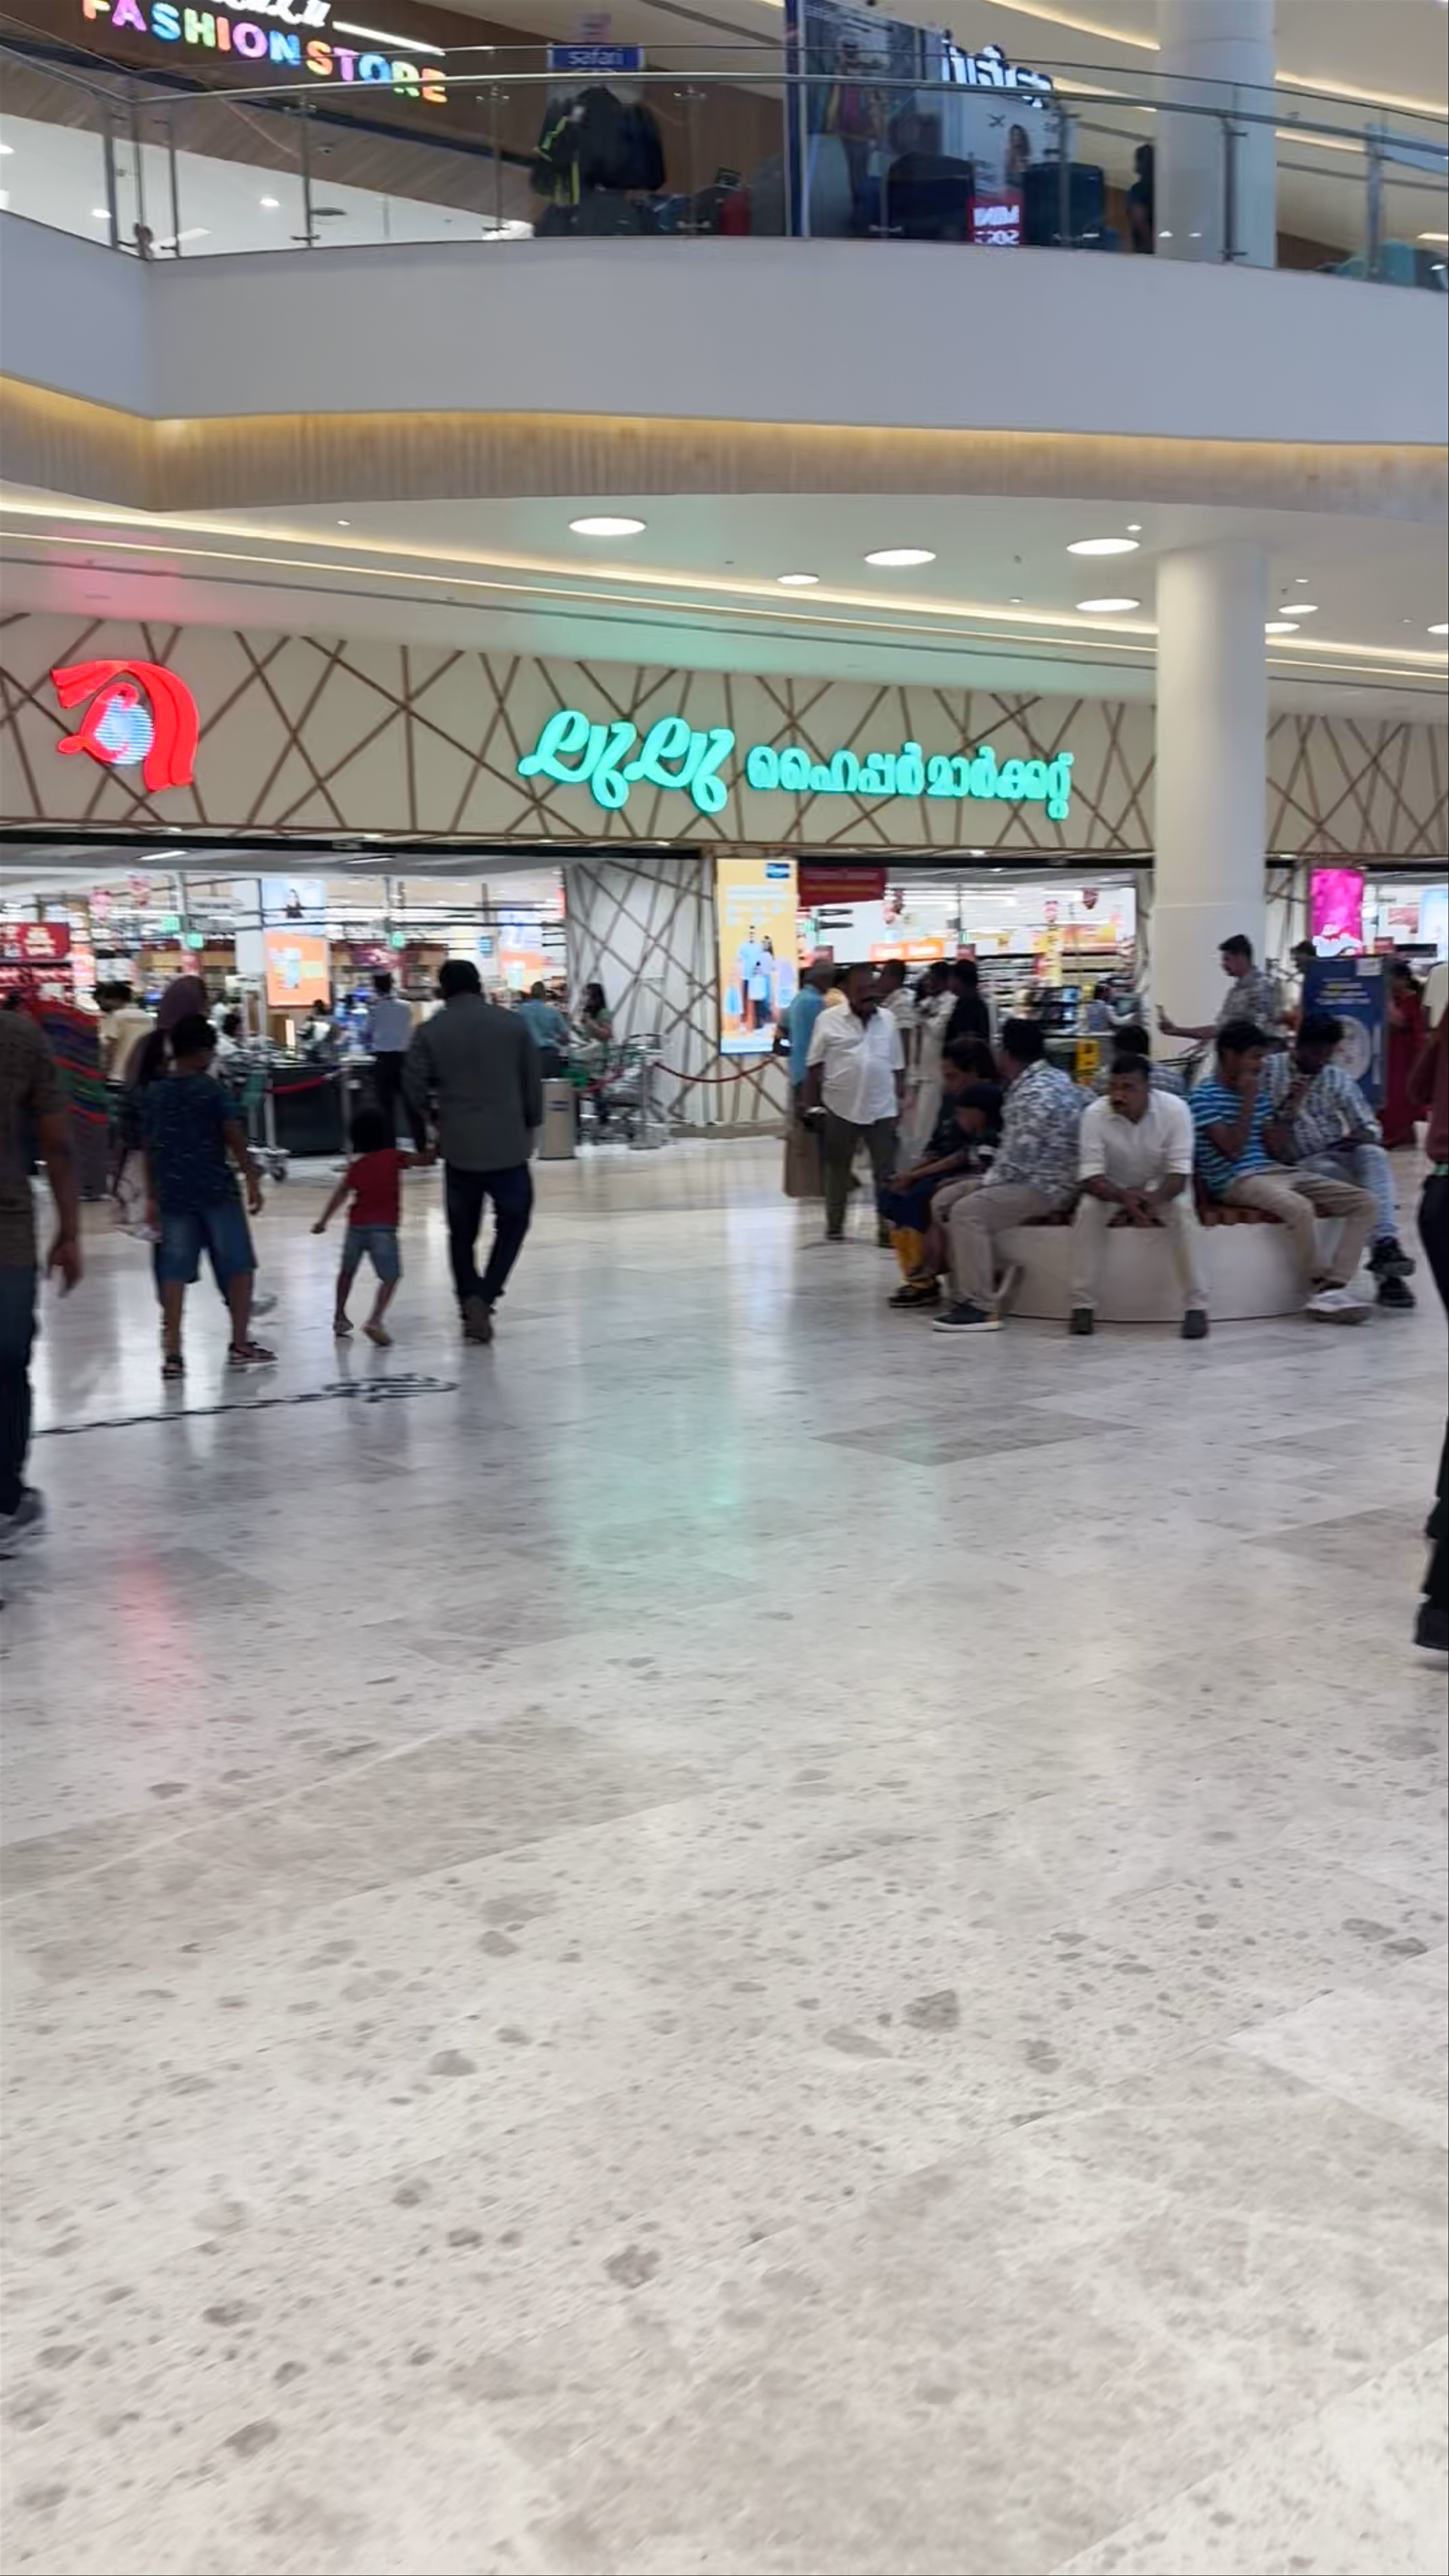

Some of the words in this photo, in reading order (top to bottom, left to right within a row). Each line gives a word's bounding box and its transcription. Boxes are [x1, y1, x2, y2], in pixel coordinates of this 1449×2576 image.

[82, 0, 301, 65] FASHION
[305, 40, 448, 103] STORE
[568, 48, 623, 65] safari
[518, 709, 735, 814] ലുലു
[747, 741, 1075, 820] ഹൈപ്പർമാർക്കറ്റ്
